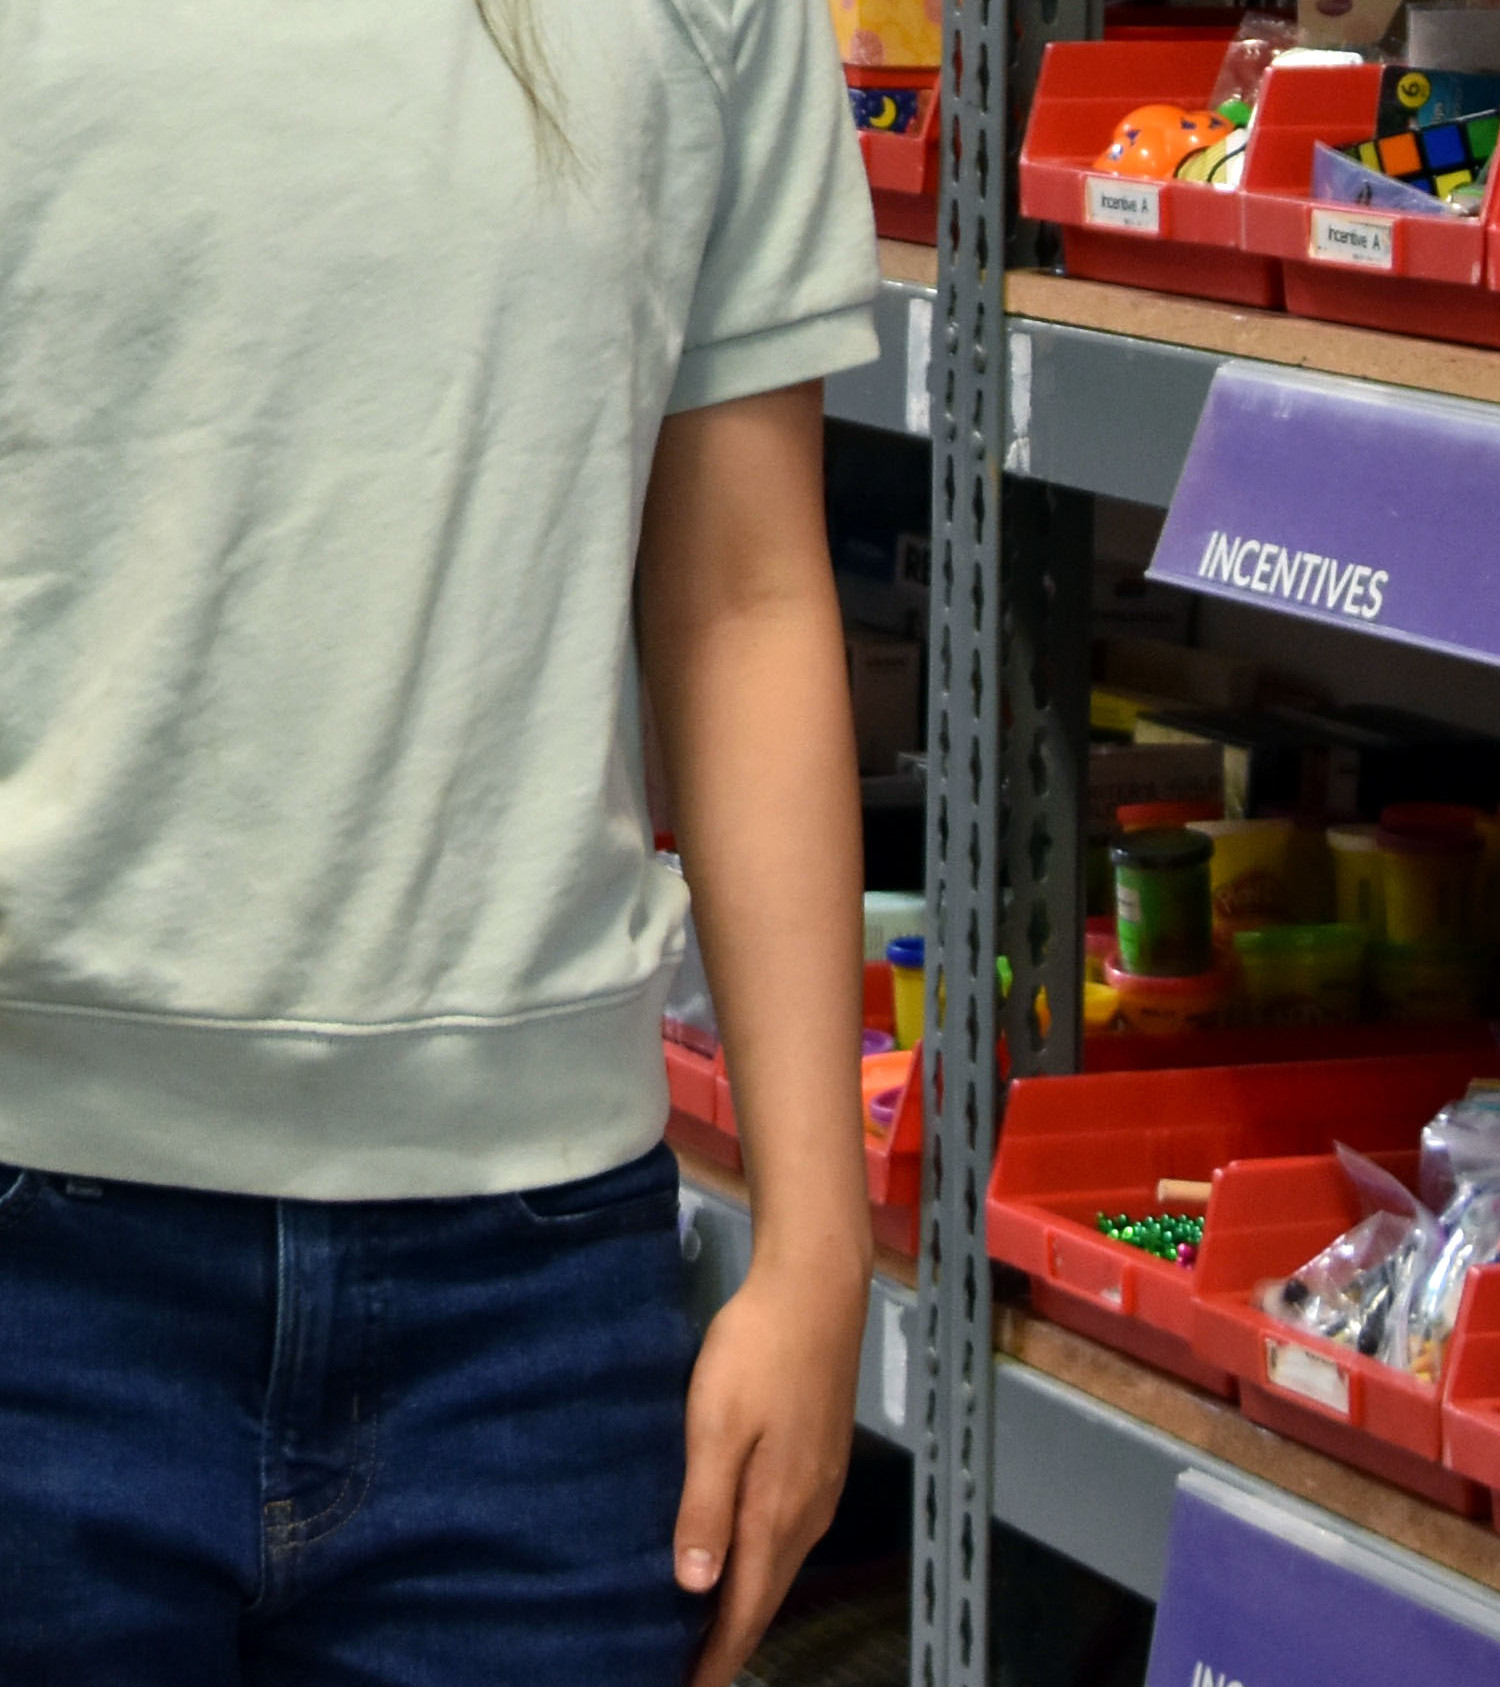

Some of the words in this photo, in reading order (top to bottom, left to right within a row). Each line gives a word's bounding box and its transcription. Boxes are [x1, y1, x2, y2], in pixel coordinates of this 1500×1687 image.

[1141, 196, 1150, 213] A
[1328, 224, 1367, 248] Incentive
[1372, 232, 1381, 251] A
[1198, 530, 1390, 620] INCENTIVES
